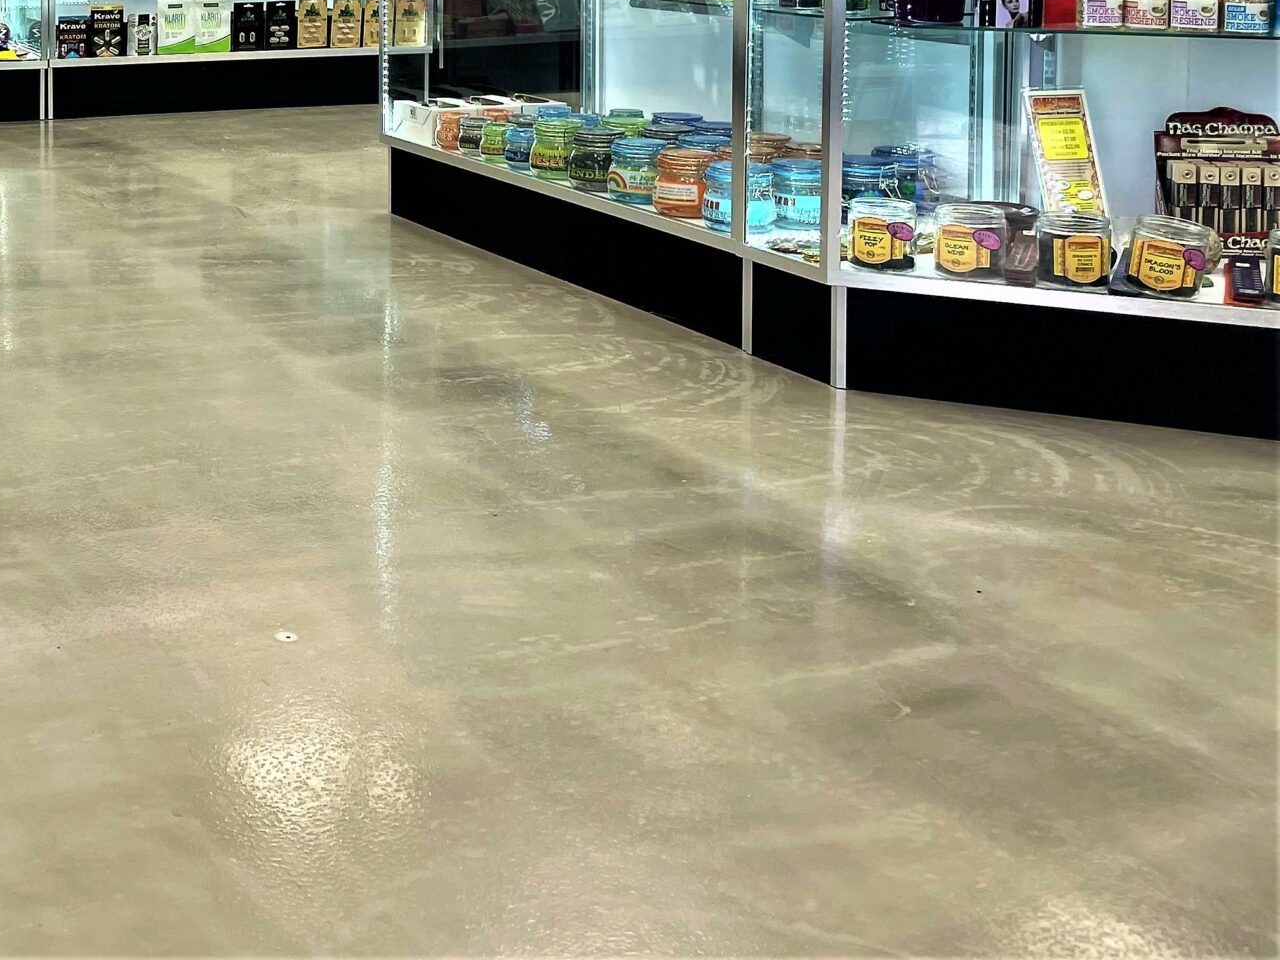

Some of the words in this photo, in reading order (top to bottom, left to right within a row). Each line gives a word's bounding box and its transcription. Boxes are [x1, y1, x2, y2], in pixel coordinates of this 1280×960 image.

[94, 12, 120, 20] Krave
[1086, 7, 1116, 16] SMOKE
[1226, 13, 1257, 22] SMOKE
[1168, 122, 1202, 136] Nag
[1205, 122, 1277, 137] Champa
[859, 234, 884, 244] FIZZY
[1144, 257, 1181, 271] DRAGON'S
[1148, 266, 1174, 276] BLOOD
